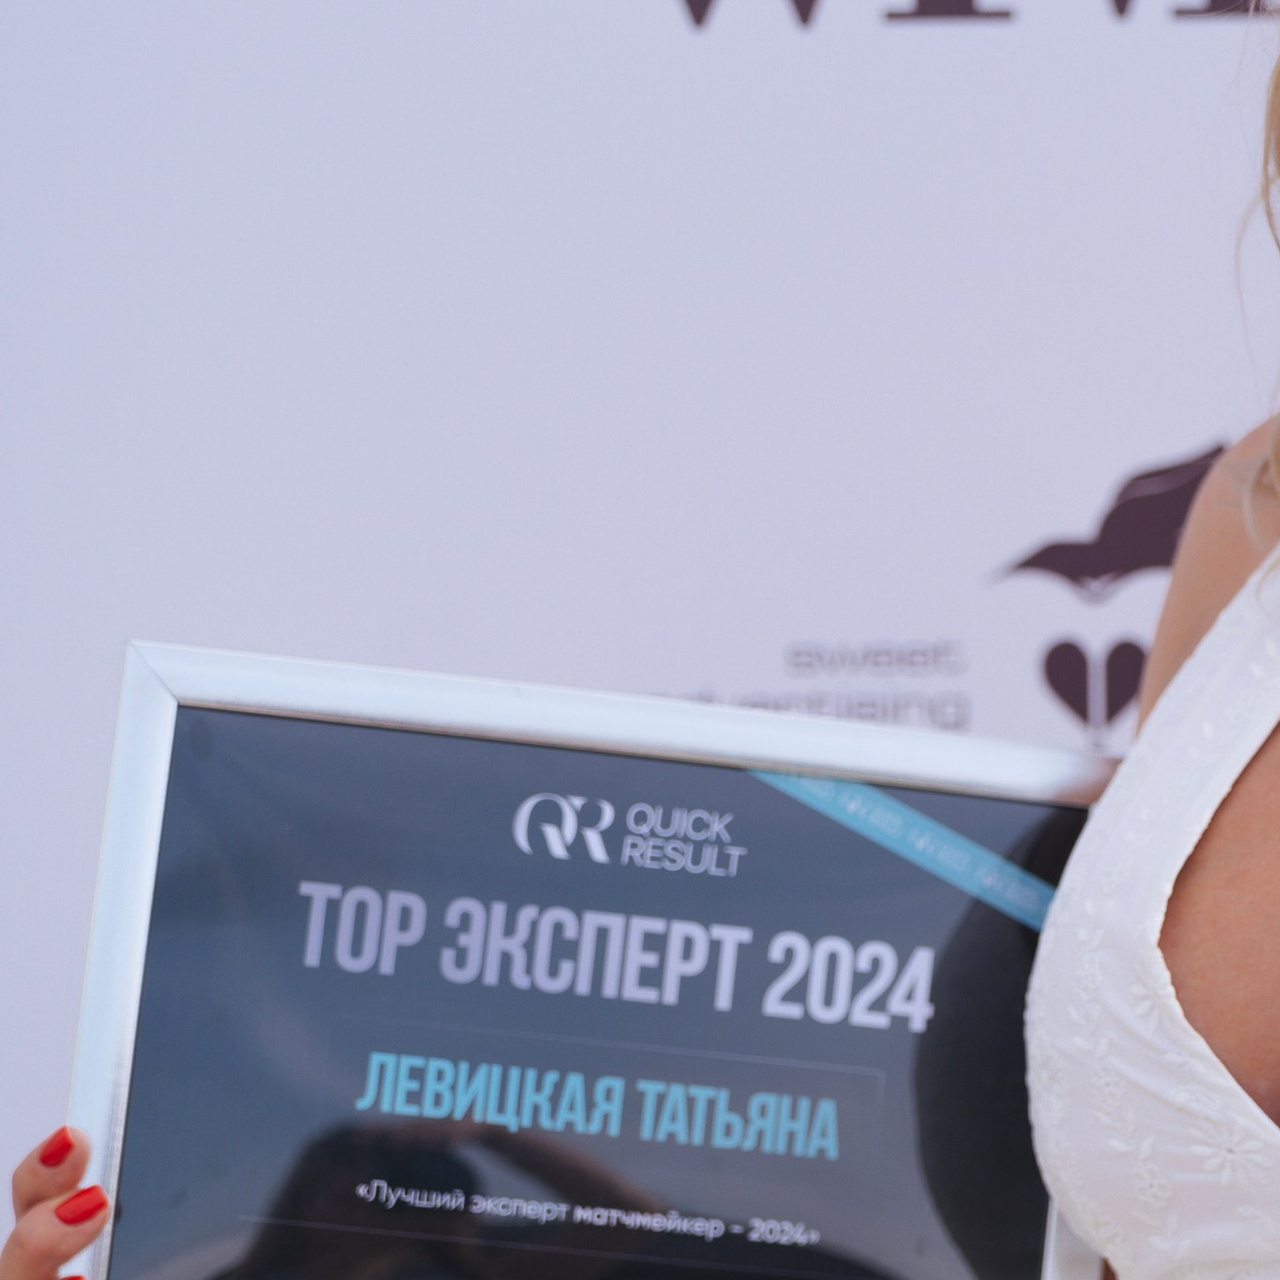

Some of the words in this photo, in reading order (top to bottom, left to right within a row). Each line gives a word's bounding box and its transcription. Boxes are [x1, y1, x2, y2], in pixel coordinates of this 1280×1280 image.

[625, 801, 735, 844] QUICK
[620, 834, 749, 878] RESULT
[299, 880, 427, 976] TOP
[439, 895, 753, 1013] ЭКСПЕРТ
[761, 930, 935, 1035] 2024
[355, 1051, 625, 1138] ЛЕВИЦКАЯ
[636, 1079, 840, 1161] ТАТЬЯНА
[355, 1178, 466, 1211] «Лучший
[468, 1194, 570, 1224] эксперт
[572, 1204, 727, 1242] матчмейкер
